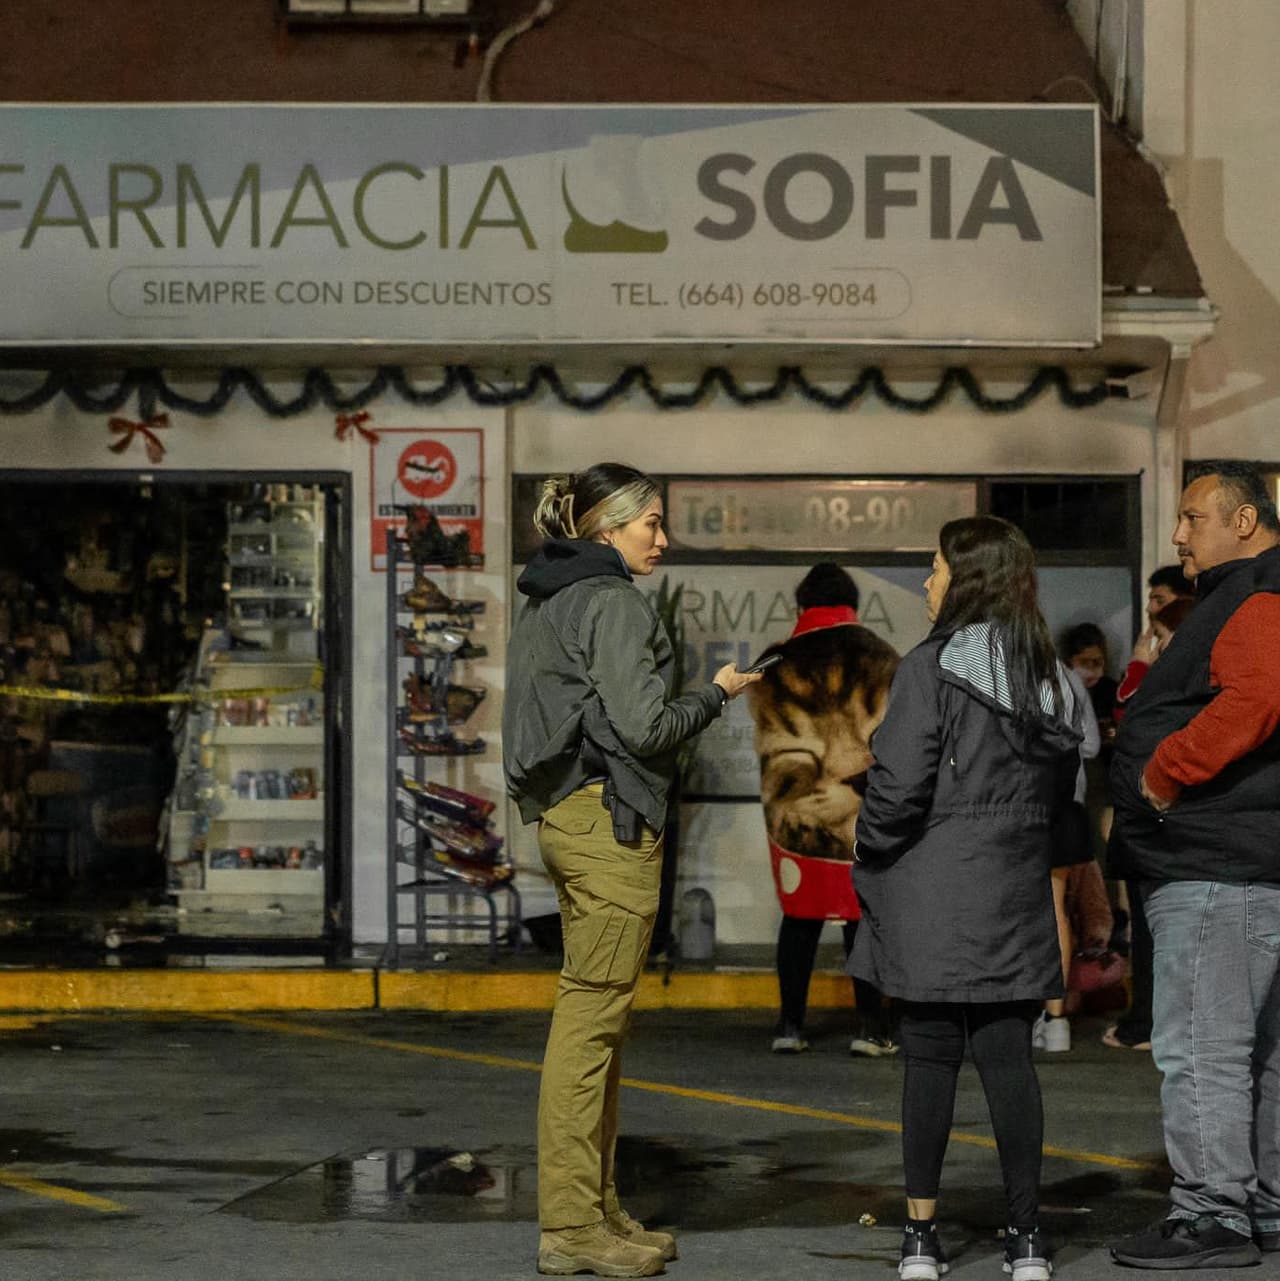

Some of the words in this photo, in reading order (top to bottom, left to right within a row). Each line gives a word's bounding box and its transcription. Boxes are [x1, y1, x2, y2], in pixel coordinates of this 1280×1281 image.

[693, 152, 1045, 242] SOFIA
[142, 280, 267, 306] SIEMPRE
[275, 280, 345, 306] CON
[353, 280, 553, 308] DESCUENTOS
[611, 283, 669, 307] TEL.
[677, 282, 745, 309] (664)
[753, 282, 877, 307] 608-9084
